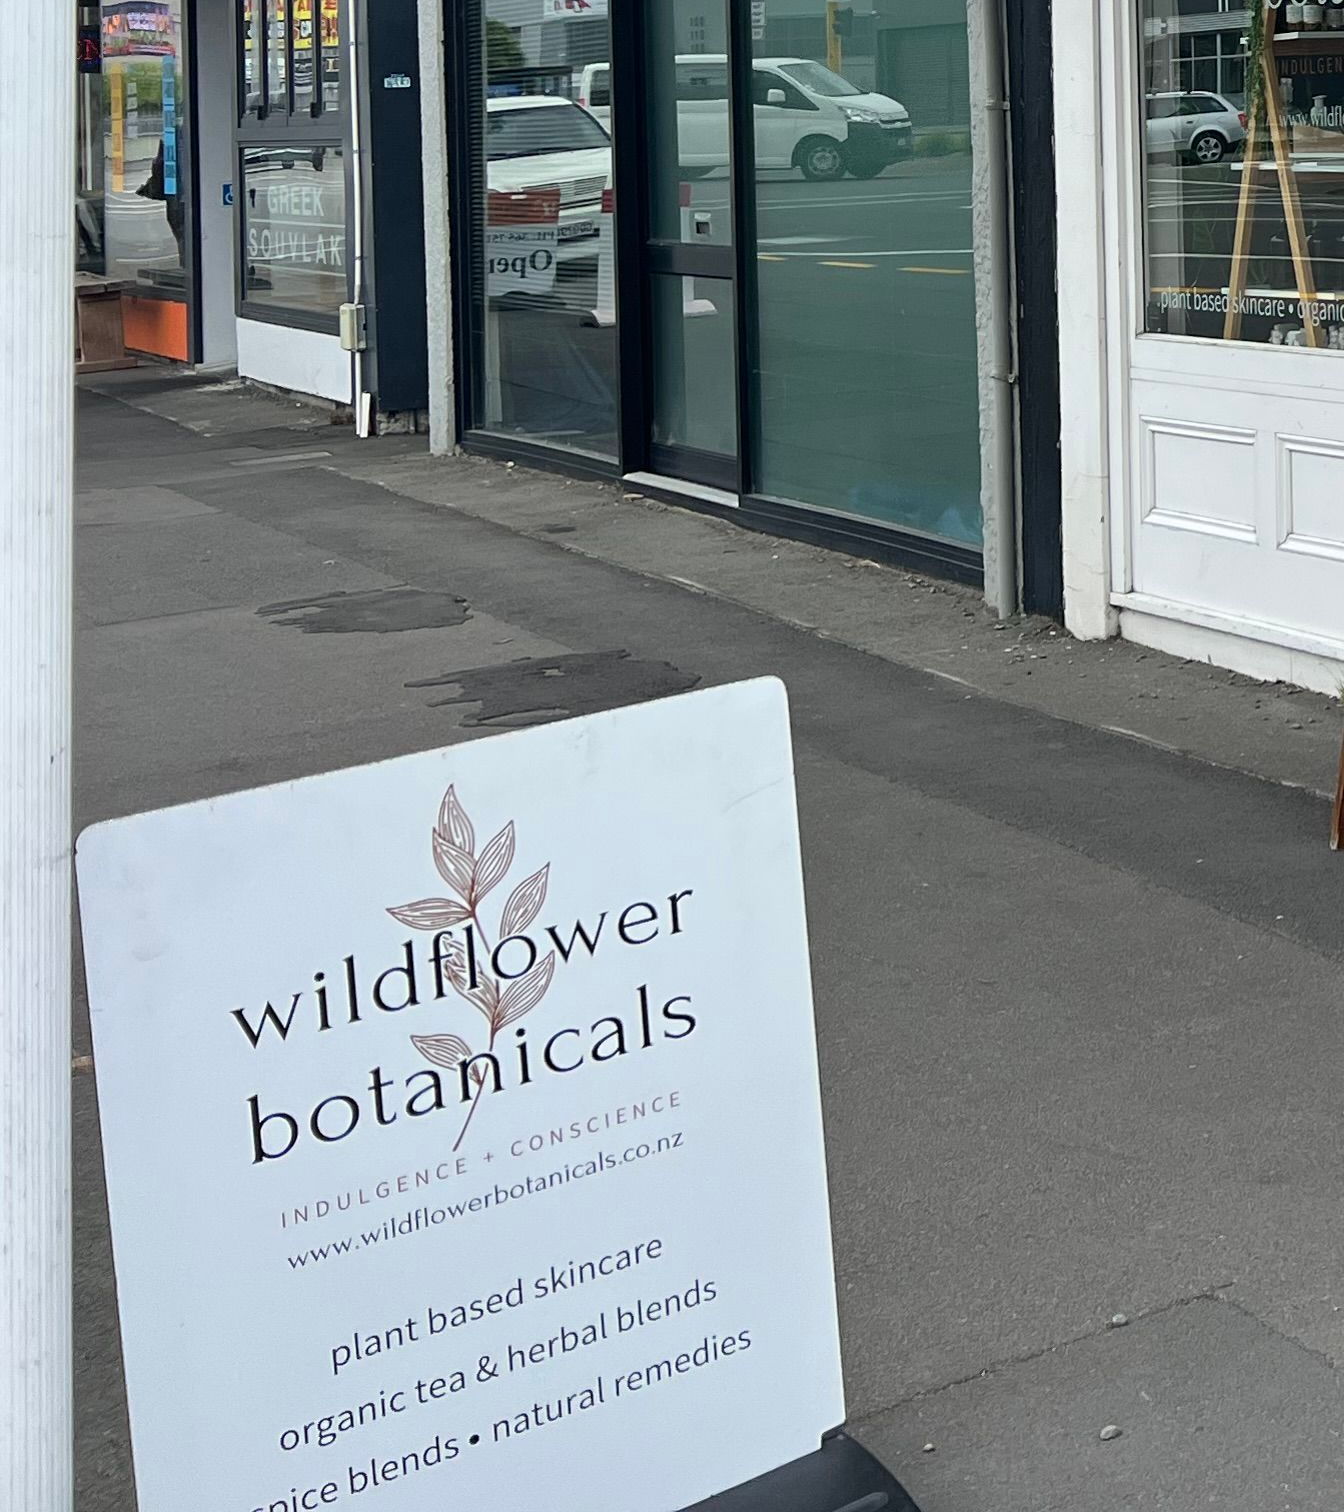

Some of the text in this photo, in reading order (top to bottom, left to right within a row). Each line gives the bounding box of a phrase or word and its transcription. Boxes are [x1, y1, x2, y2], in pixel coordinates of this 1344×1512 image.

[249, 228, 342, 267] SOUVLAK
[267, 186, 325, 217] GREEK
[1160, 287, 1191, 315] plant
[1194, 287, 1229, 313] based
[1232, 292, 1286, 318] skincare
[230, 886, 696, 1050] wildflower
[247, 982, 699, 1166] botanicals
[279, 1157, 468, 1229] INDULGENCE
[510, 1090, 683, 1158] CONSCIENCE
[286, 1130, 686, 1270] www.wildflowerbotanicals.co.nz
[280, 1275, 718, 1451] organic tea & herbal blends
[331, 1235, 664, 1375] plant based skincare
[251, 1327, 753, 1512] pice blends natural remedies
